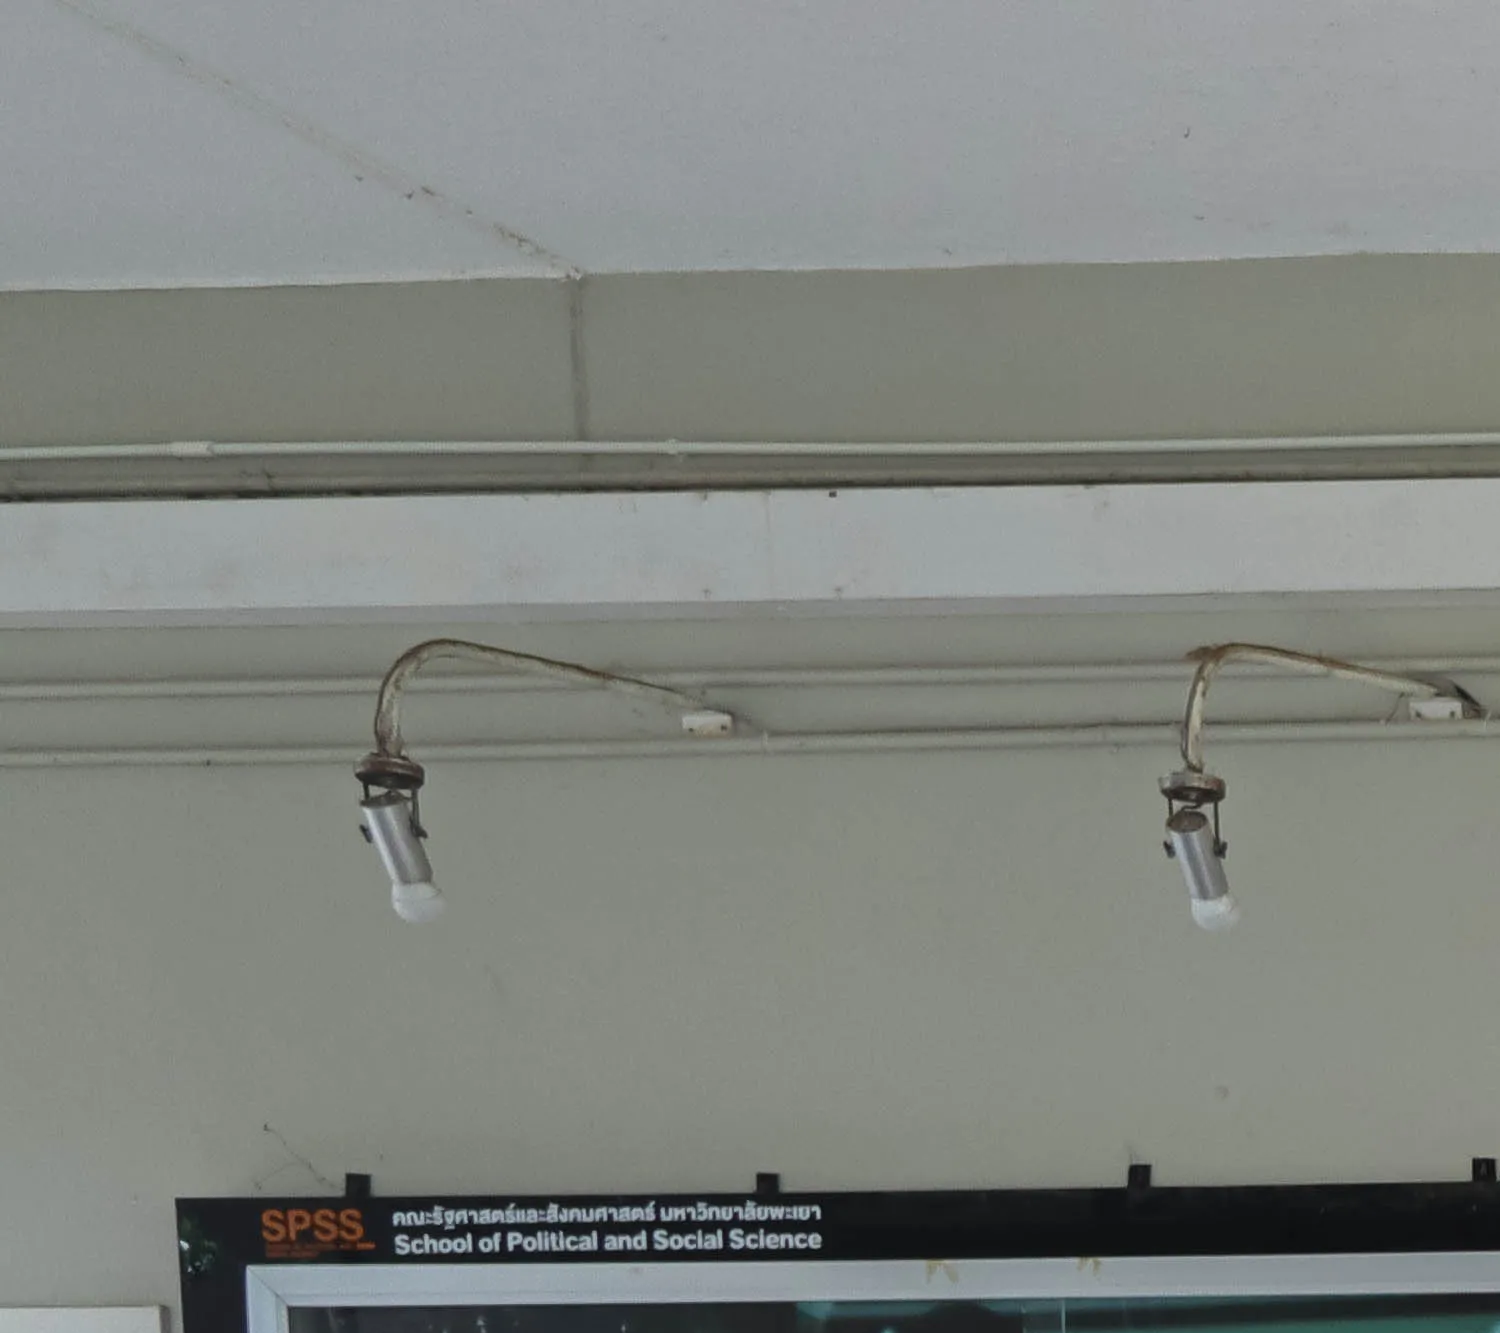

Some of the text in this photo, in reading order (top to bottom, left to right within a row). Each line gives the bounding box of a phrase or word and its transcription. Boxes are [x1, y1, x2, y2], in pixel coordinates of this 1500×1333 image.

[261, 1208, 366, 1242] SPSS
[394, 1232, 473, 1256] School
[477, 1231, 502, 1253] of
[506, 1230, 599, 1252] Political
[603, 1229, 648, 1251] and
[652, 1228, 724, 1251] Social
[728, 1227, 823, 1250] Science
